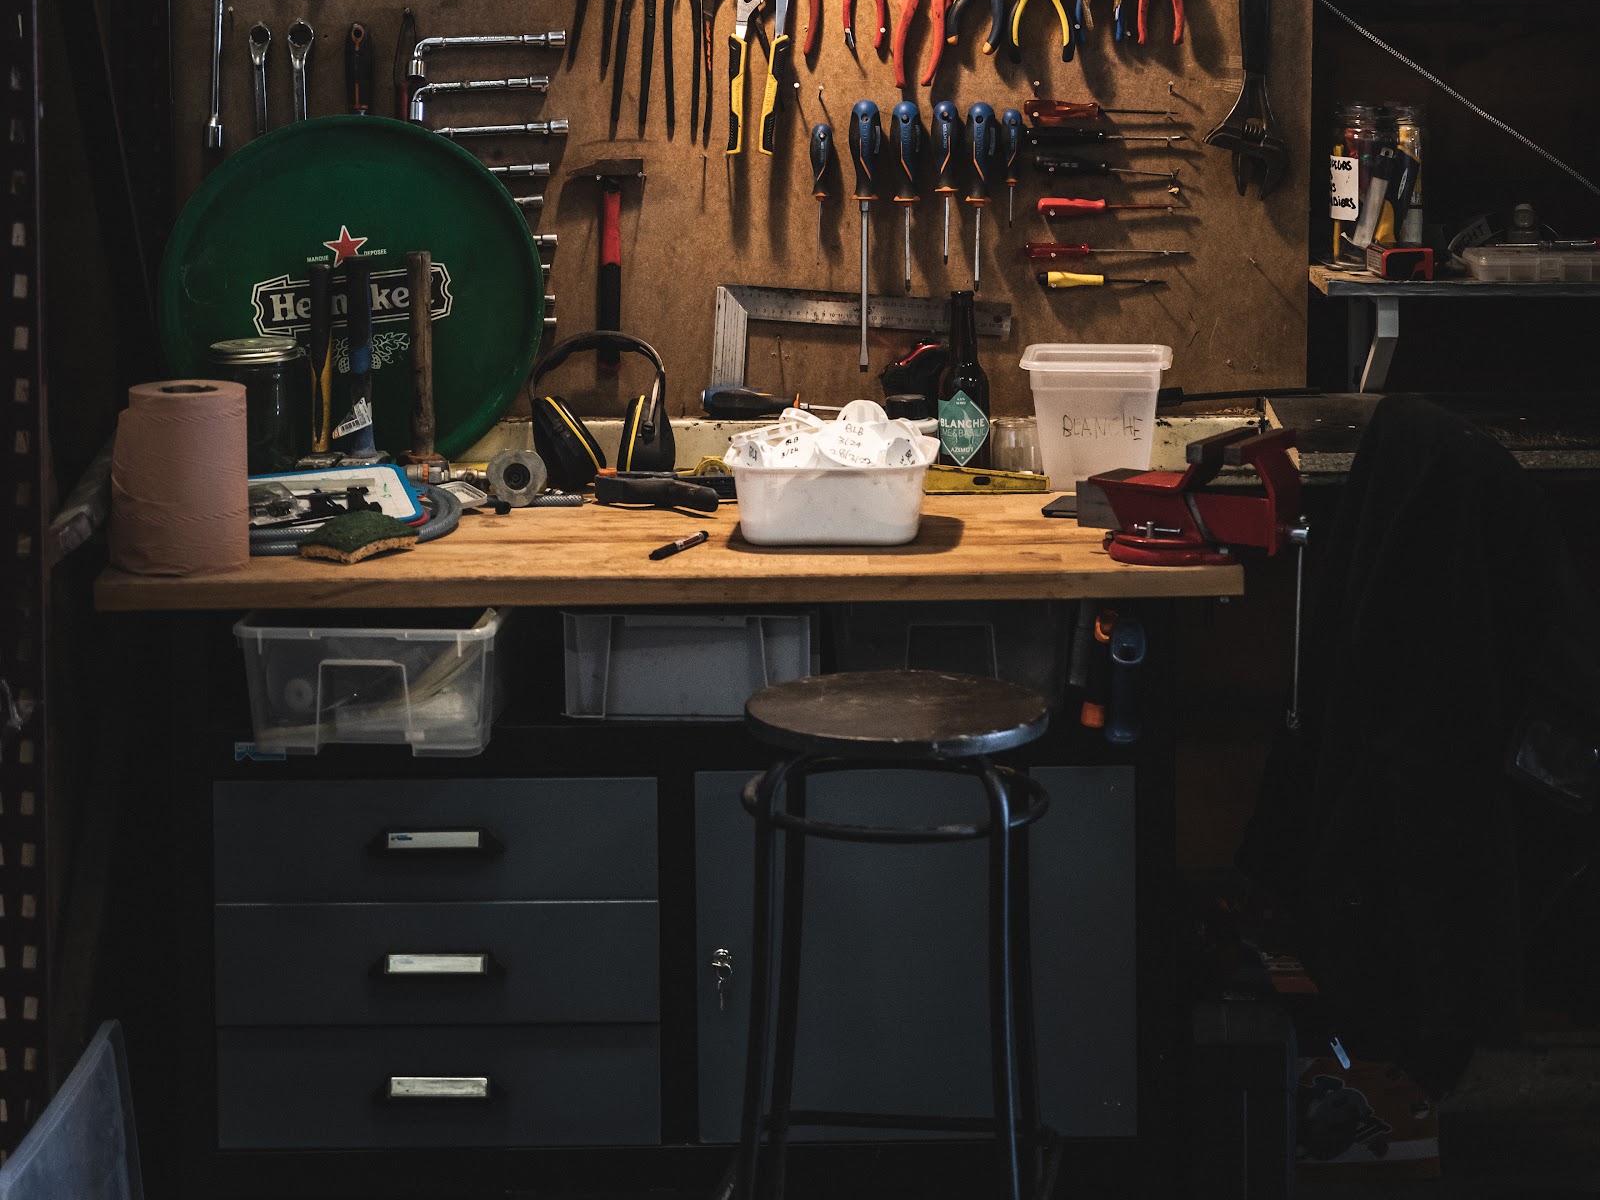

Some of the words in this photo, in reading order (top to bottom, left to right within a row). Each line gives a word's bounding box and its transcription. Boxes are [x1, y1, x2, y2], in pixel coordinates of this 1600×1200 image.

[307, 255, 329, 263] MARQUE
[940, 418, 985, 429] BLANCHE
[1062, 414, 1143, 440] BLANCHE
